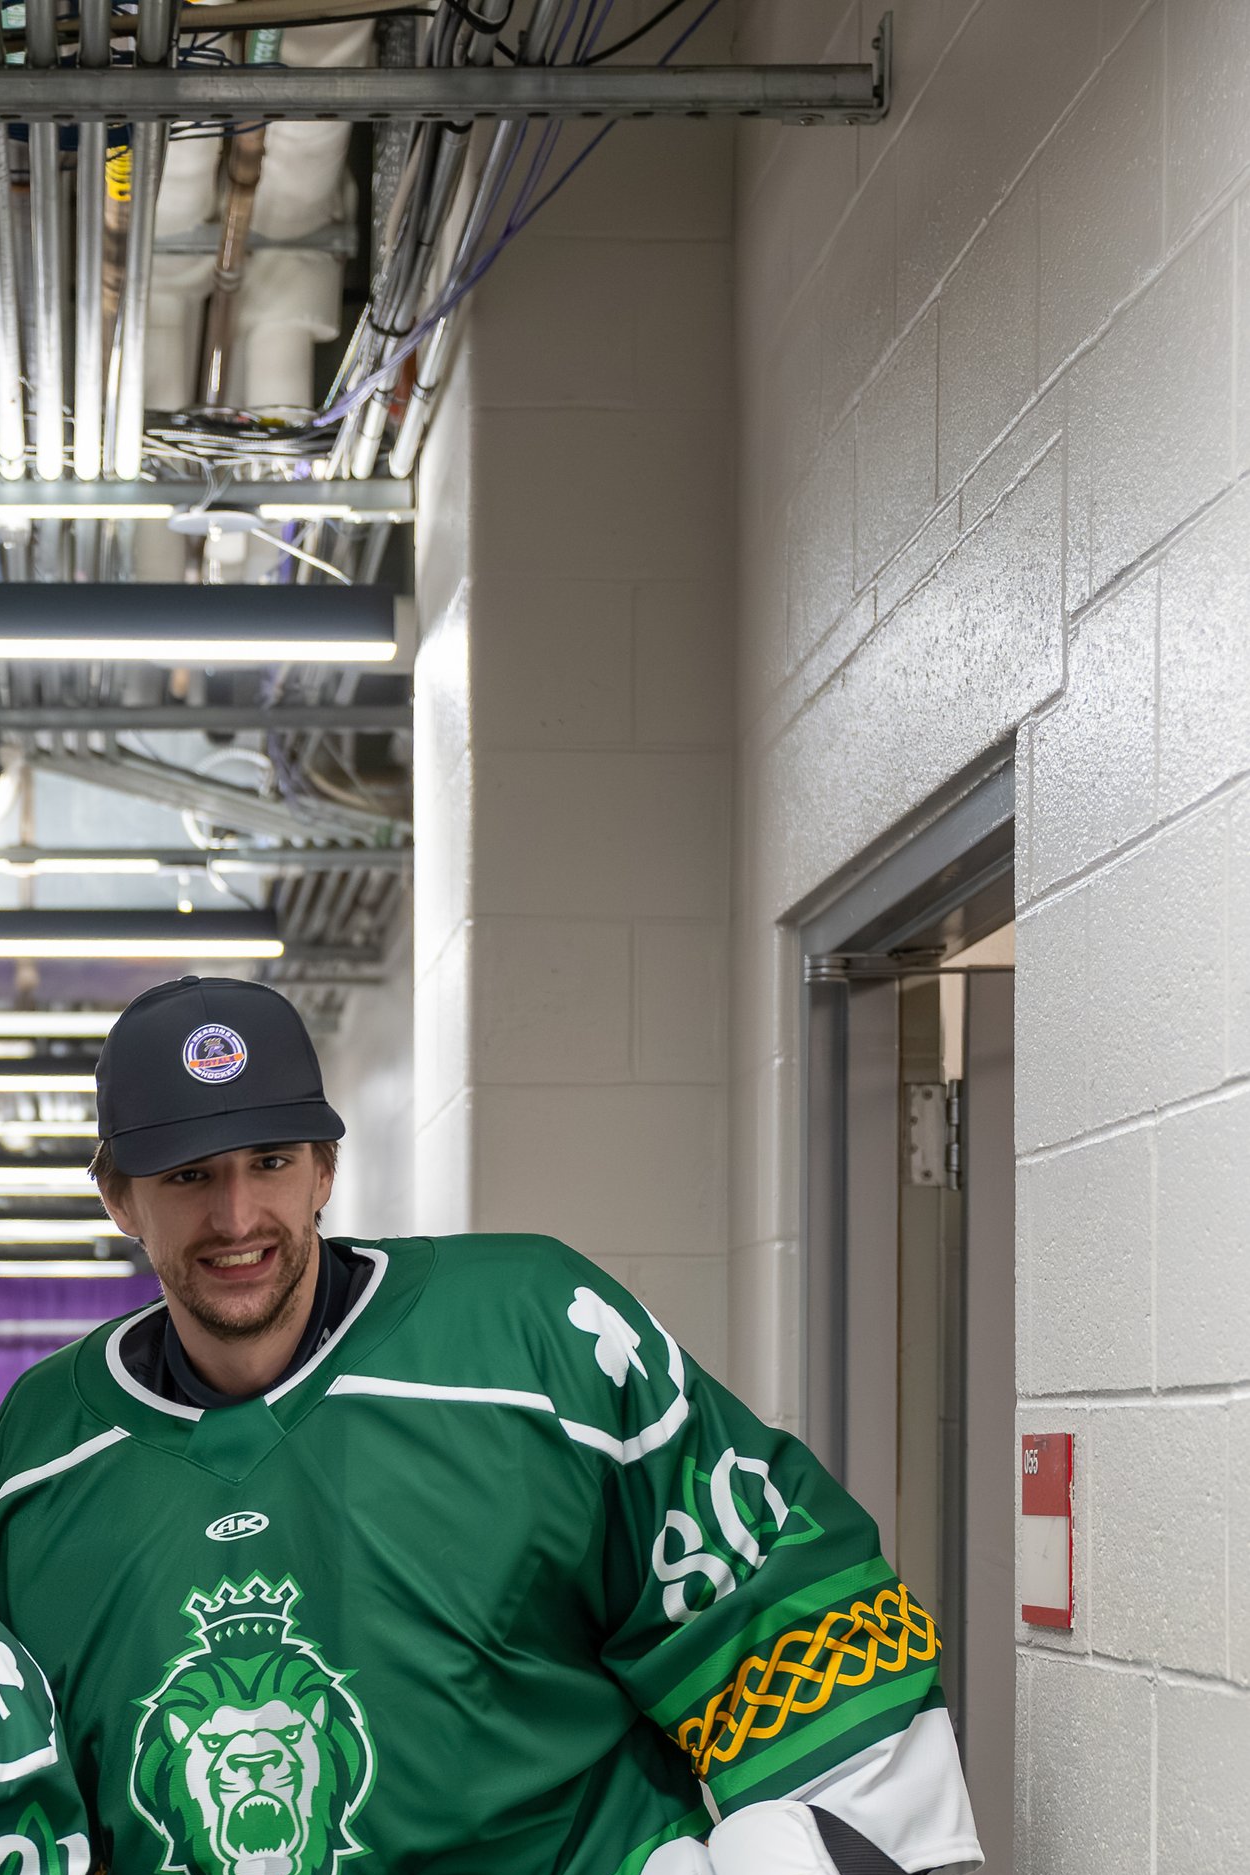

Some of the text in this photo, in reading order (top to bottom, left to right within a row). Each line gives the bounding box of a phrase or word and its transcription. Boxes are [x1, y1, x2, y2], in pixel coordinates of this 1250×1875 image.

[191, 1027, 232, 1043] READING
[198, 1055, 236, 1068] ROYALS
[200, 1064, 238, 1079] HOCKEY
[1024, 1449, 1039, 1475] 055
[652, 1446, 790, 1626] 80
